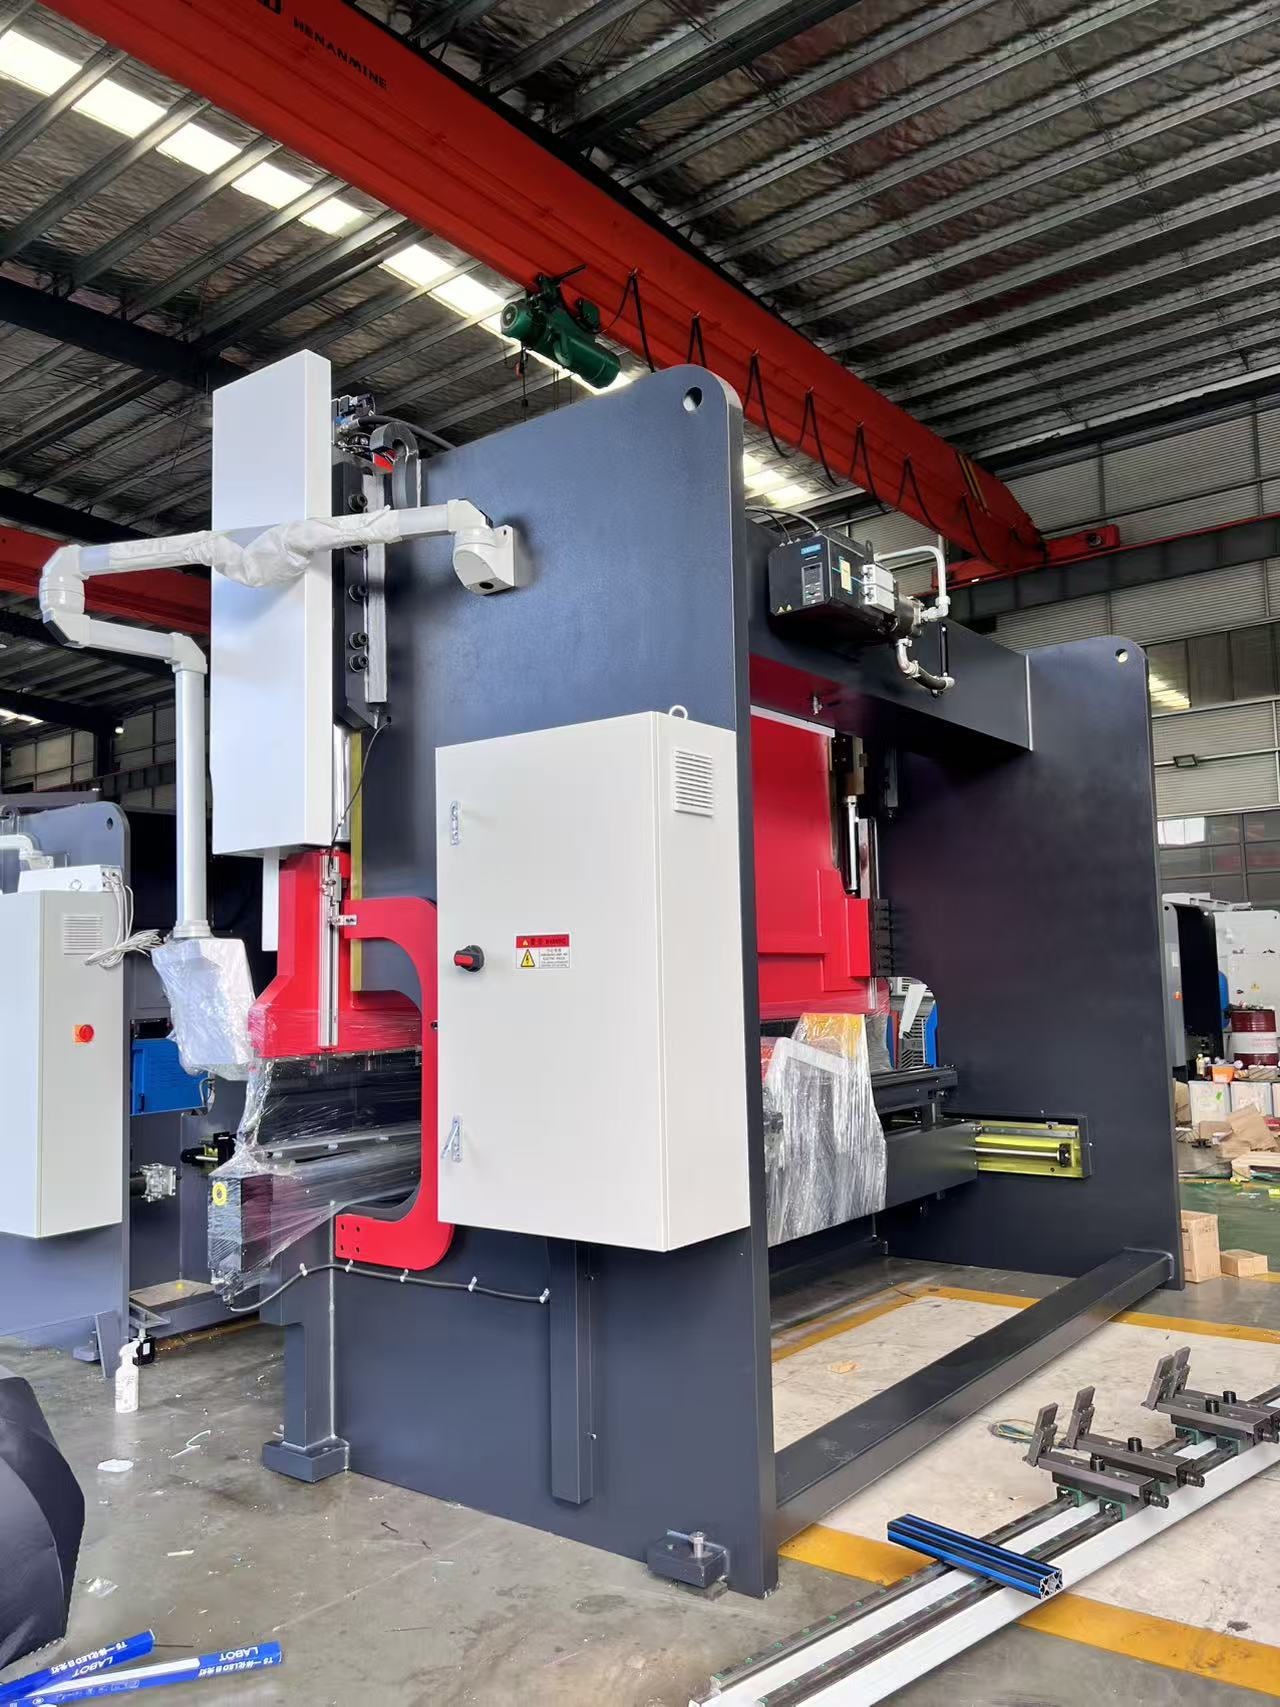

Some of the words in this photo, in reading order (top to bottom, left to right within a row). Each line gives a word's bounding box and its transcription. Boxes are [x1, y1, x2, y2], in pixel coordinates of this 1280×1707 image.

[293, 16, 388, 90] HENANMINE
[218, 1646, 259, 1662] LABOT
[72, 1655, 114, 1678] LABOT
